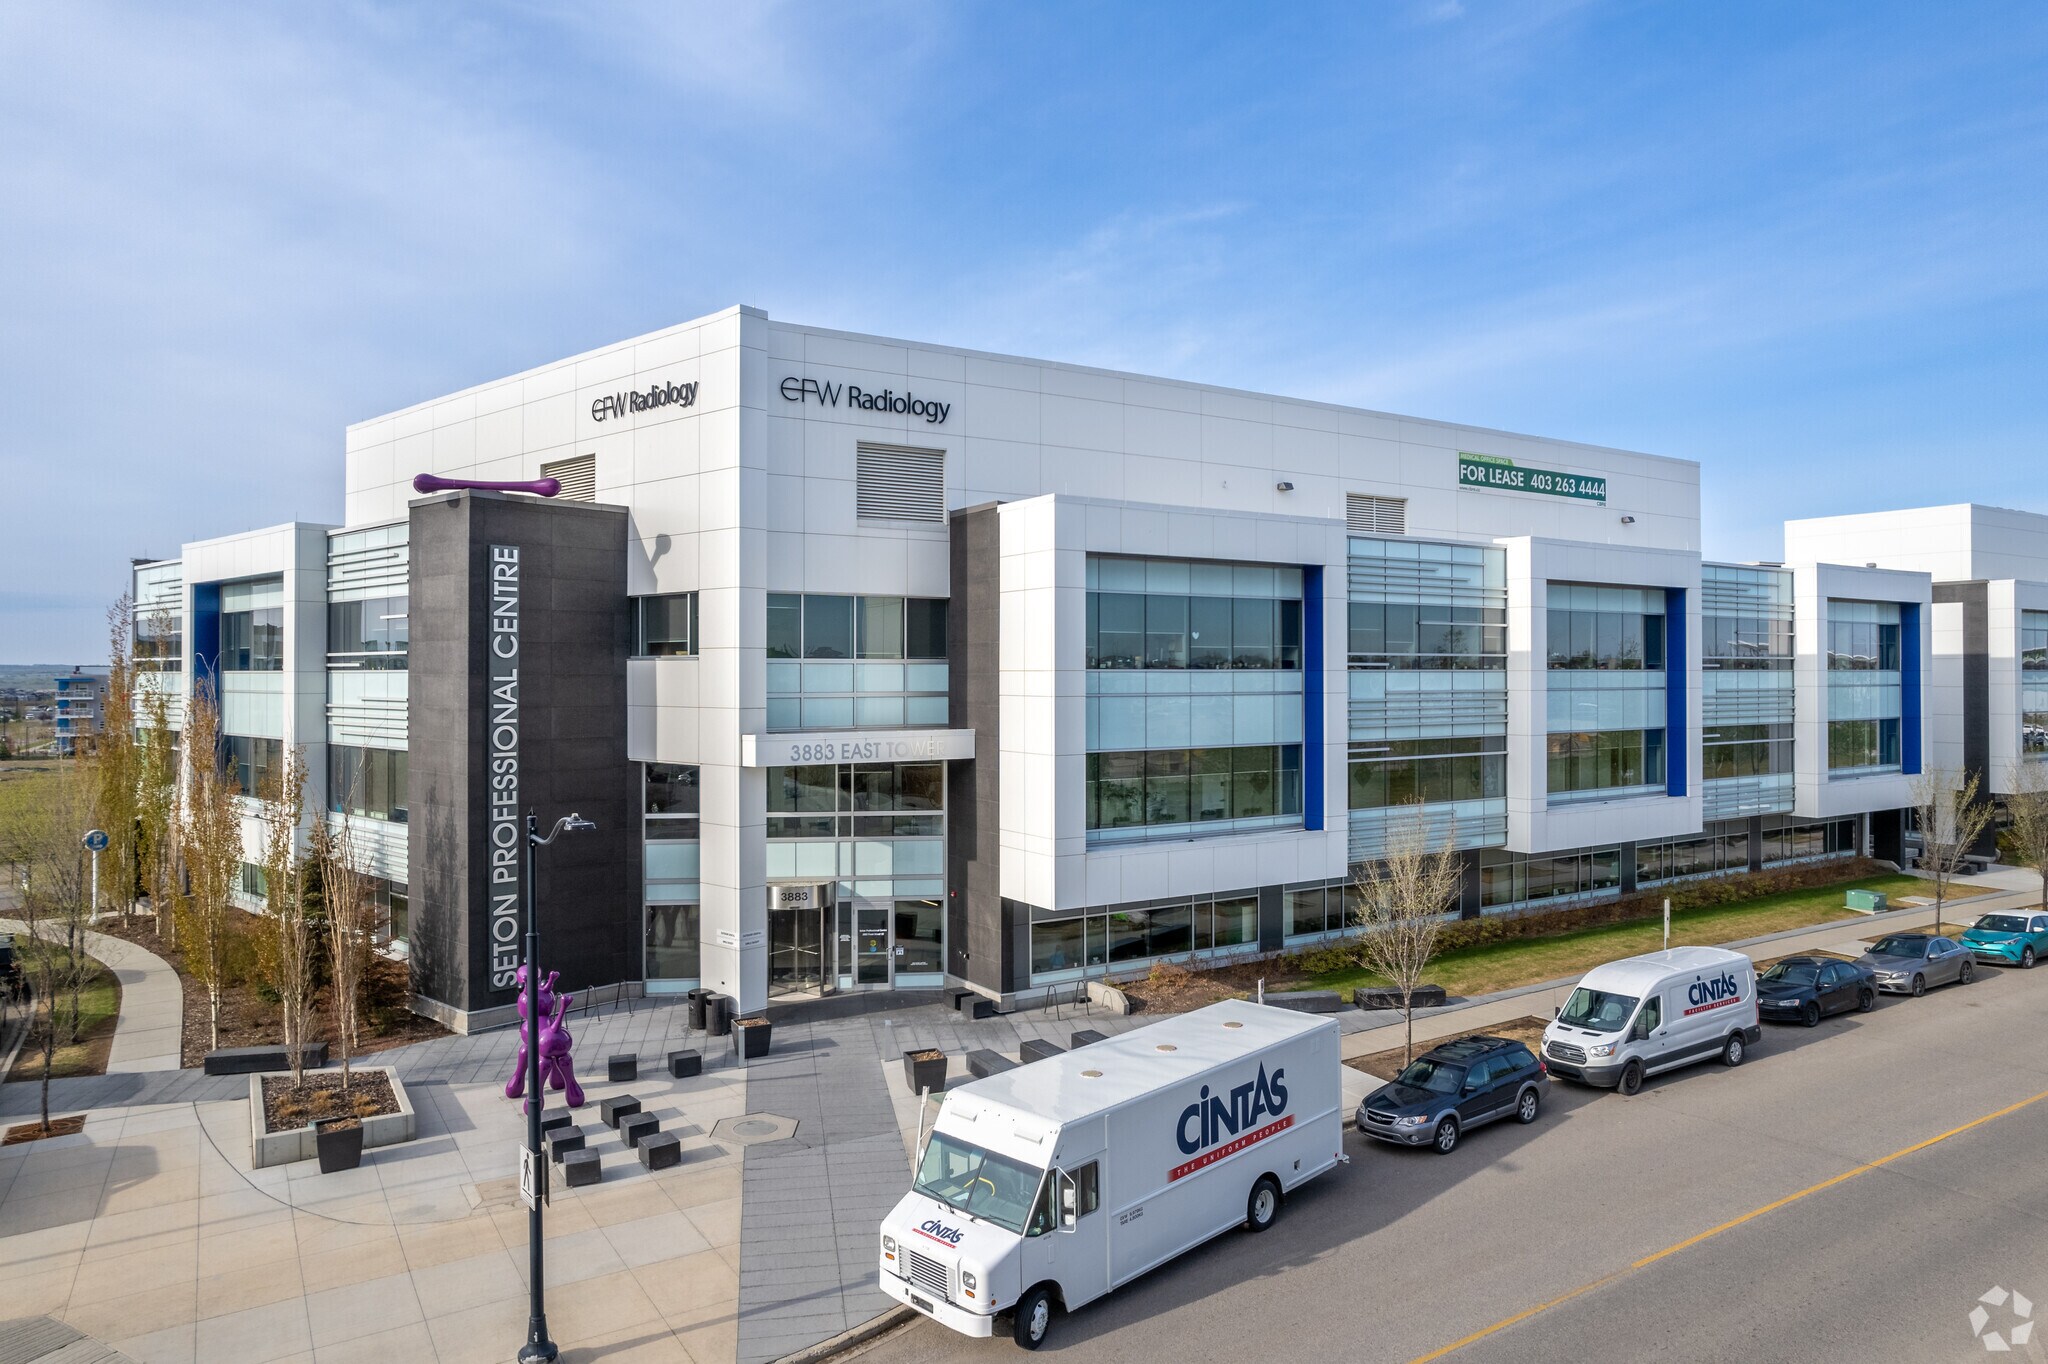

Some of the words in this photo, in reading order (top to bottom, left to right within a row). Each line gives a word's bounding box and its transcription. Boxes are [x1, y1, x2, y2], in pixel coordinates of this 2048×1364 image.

[592, 392, 628, 422] EFW
[629, 380, 699, 414] Radiology
[781, 376, 842, 407] EFW
[848, 385, 951, 424] Radiology
[1460, 464, 1486, 482] FOR
[1489, 467, 1524, 487] LEASE
[1530, 473, 1552, 490] 403
[1555, 477, 1576, 494] 263
[1578, 480, 1606, 497] 4444
[493, 548, 518, 659] CENTRE
[790, 743, 835, 762] 3883
[841, 742, 882, 760] EAST
[886, 740, 945, 758] TOWER
[492, 668, 518, 884] PROFESSIONAL
[781, 892, 808, 902] 3883
[493, 894, 518, 988] SETON
[1177, 1163, 1195, 1176] THE
[1202, 1139, 1246, 1165] UNIFORM
[1253, 1120, 1287, 1144] PEOPLE
